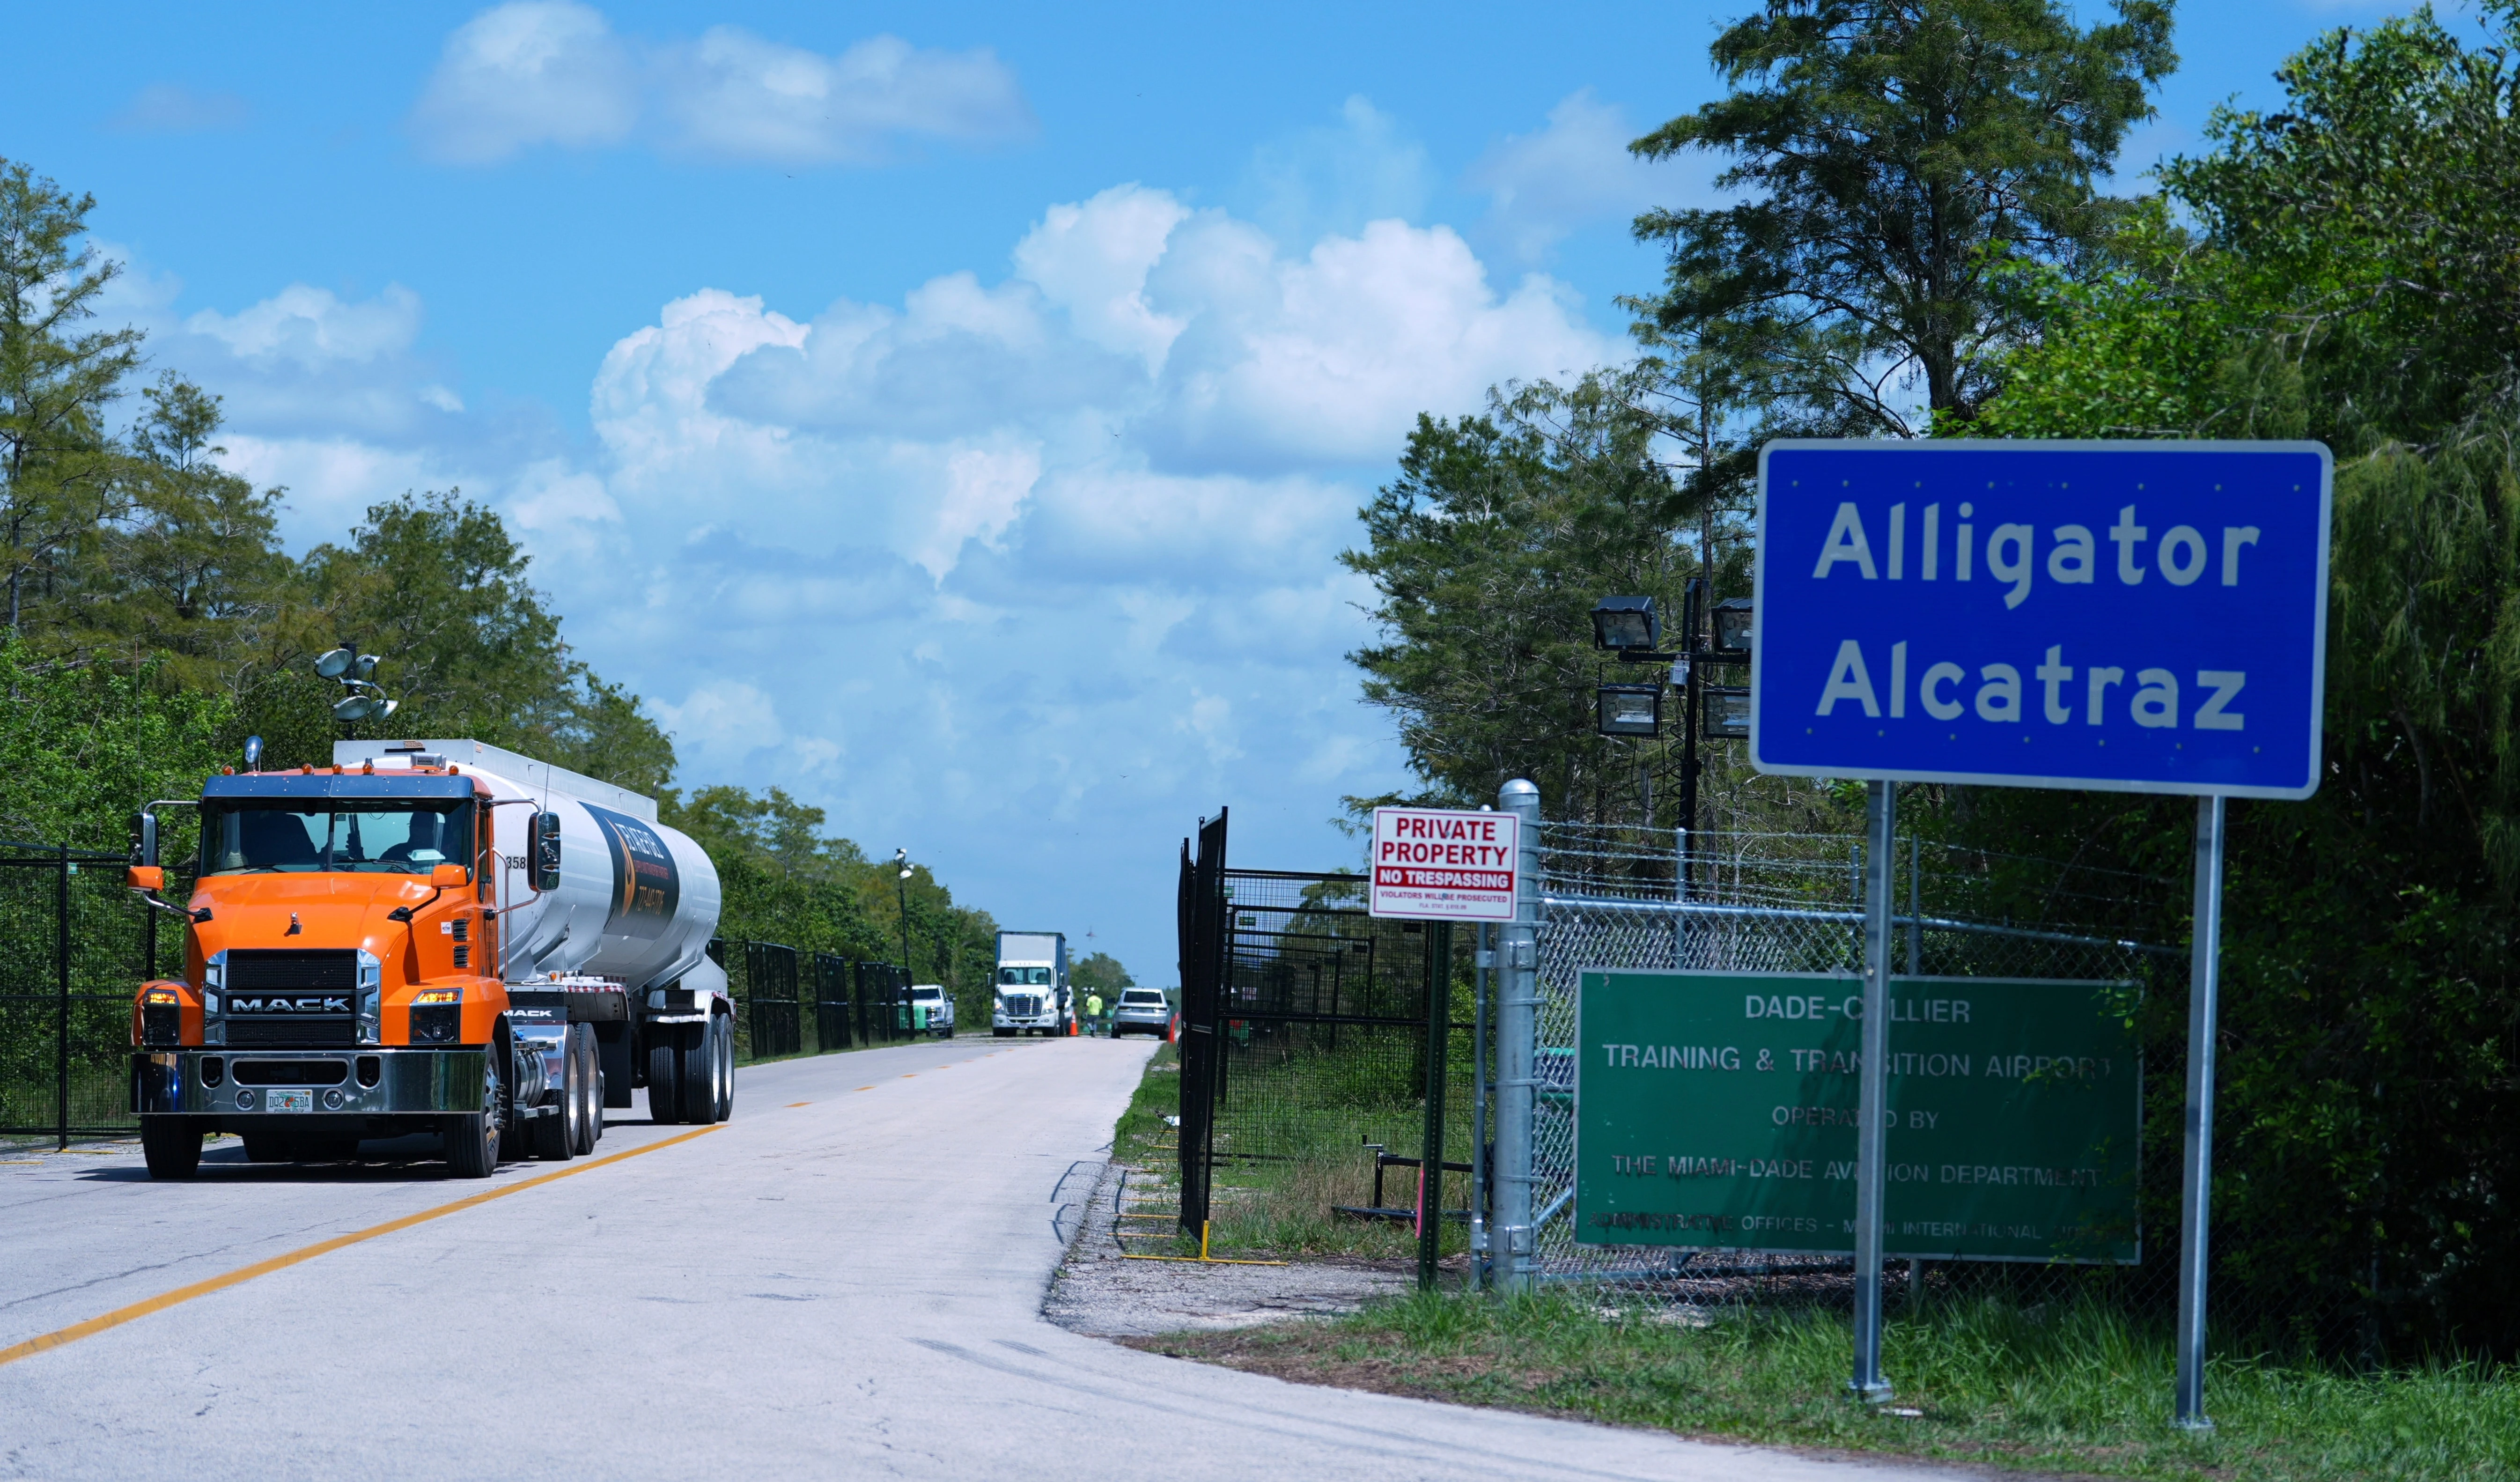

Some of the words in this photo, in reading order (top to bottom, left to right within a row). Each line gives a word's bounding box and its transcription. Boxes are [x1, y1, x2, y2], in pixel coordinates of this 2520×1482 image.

[1812, 501, 2262, 611] Alligator
[1815, 639, 2247, 731] Alcatraz
[1396, 817, 1496, 841] PRIVATE
[1382, 841, 1509, 866] PROPERTY
[1379, 869, 1402, 885] NO
[1406, 870, 1509, 888] TRESPASSING
[1380, 891, 1422, 900] VIOLATORS
[1424, 892, 1443, 900] WILL
[1457, 894, 1507, 903] PROSECUTED
[232, 997, 350, 1013] MACK
[1745, 995, 1970, 1023] DADE-CLLIER
[1603, 1044, 1741, 1071] TRAINING
[1755, 1048, 1775, 1072] &
[1772, 1106, 1898, 1128] OPERATD
[1910, 1110, 1939, 1129] BY
[1611, 1155, 1657, 1175] THE
[1668, 1156, 1813, 1179] MIAMI-DADE
[1824, 1161, 1928, 1183] AVIION
[1940, 1165, 2103, 1187] DEPARTMENT
[1741, 1216, 1817, 1233] OFFICES
[1903, 1222, 2042, 1239] INTERNATIONAL
